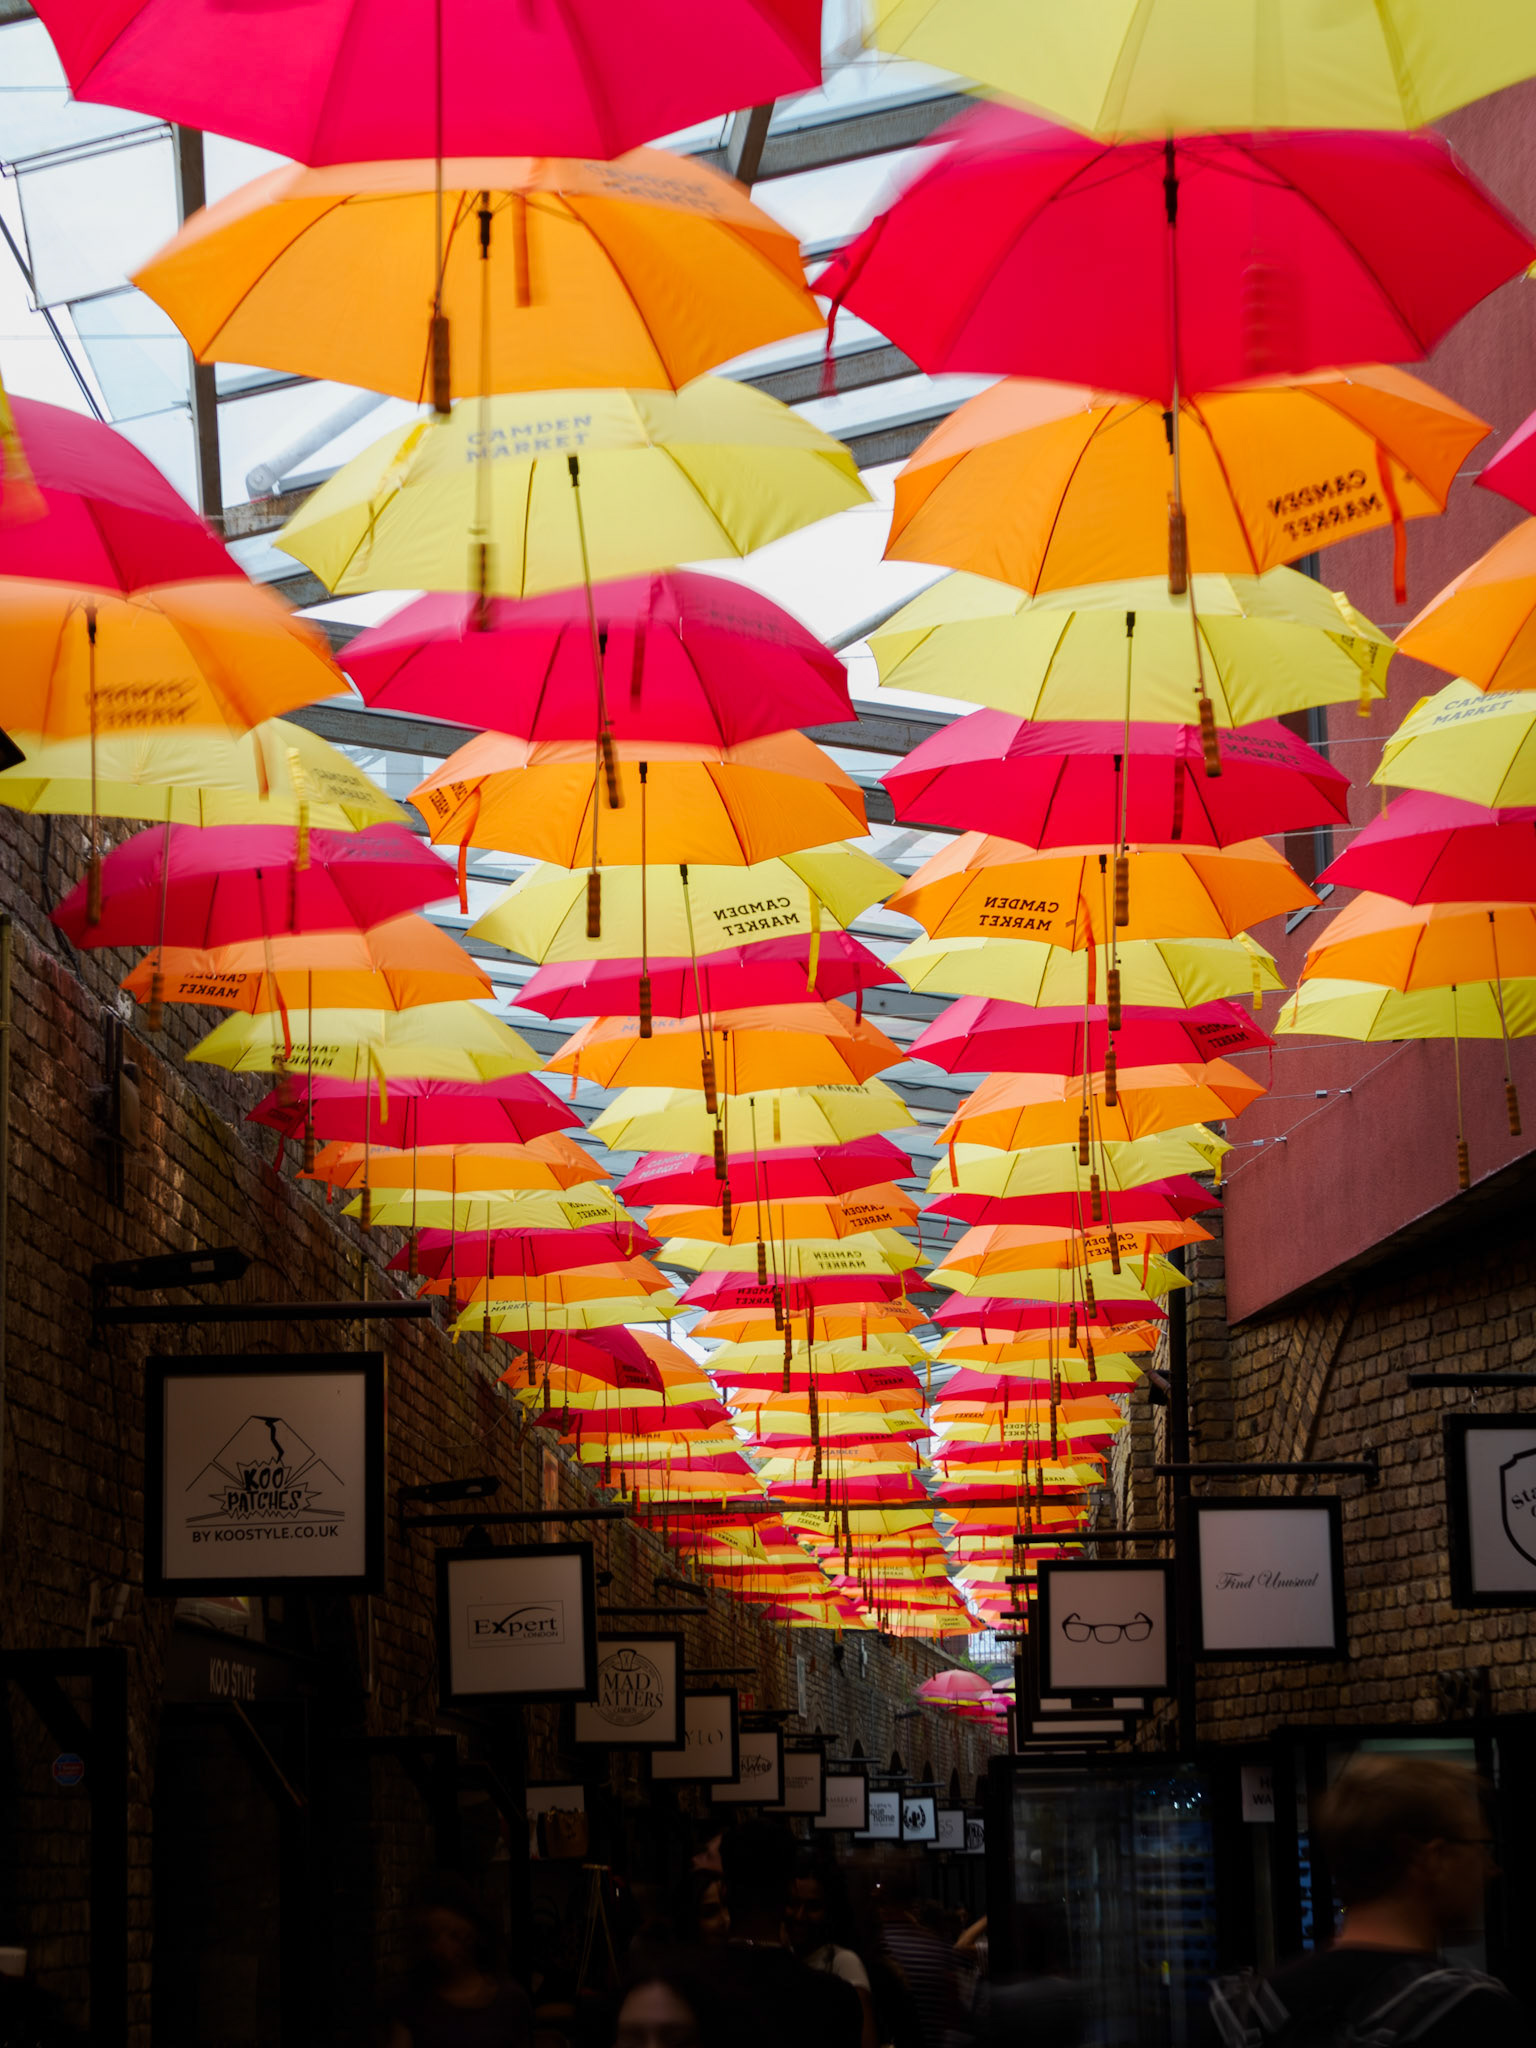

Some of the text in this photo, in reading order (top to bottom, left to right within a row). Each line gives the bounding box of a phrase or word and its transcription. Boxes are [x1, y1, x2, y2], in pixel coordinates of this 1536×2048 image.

[1432, 700, 1513, 726] MARKET
[244, 1467, 284, 1491] KOO
[227, 1490, 302, 1513] PATCHES
[192, 1525, 339, 1543] BY KOOSTYLE.CO.UK
[1216, 1569, 1320, 1590] Find Unusual
[474, 1616, 557, 1637] Expert
[523, 1631, 558, 1639] LONDON
[209, 1656, 230, 1697] KOO
[604, 1673, 651, 1690] MAD
